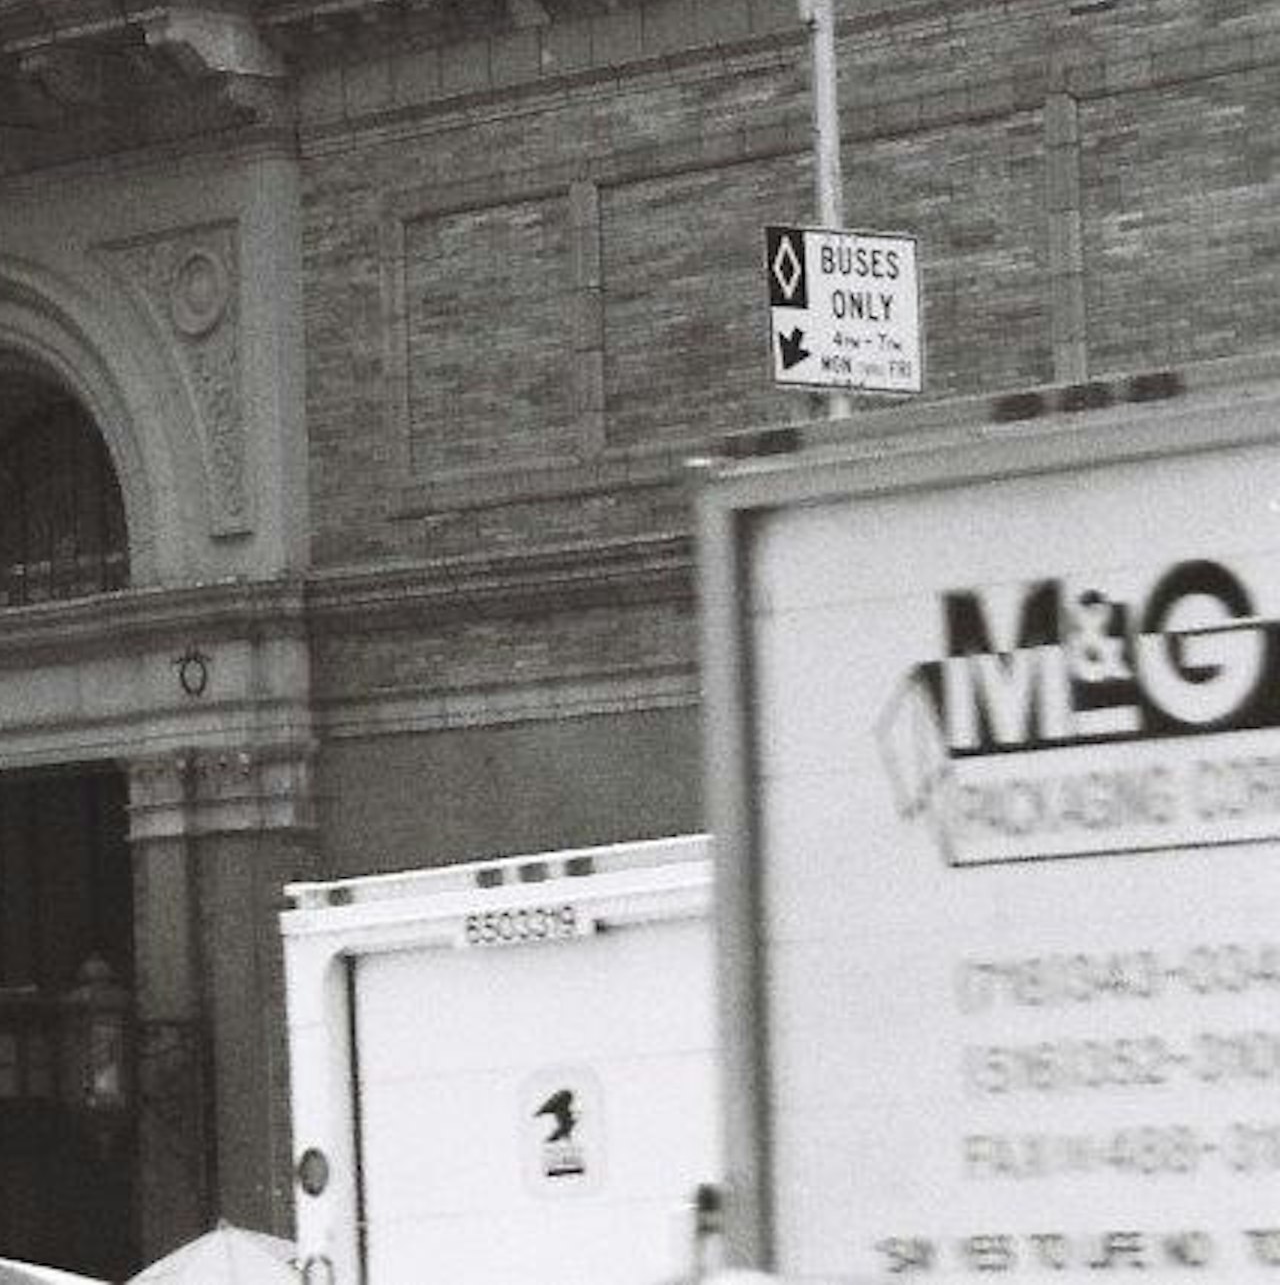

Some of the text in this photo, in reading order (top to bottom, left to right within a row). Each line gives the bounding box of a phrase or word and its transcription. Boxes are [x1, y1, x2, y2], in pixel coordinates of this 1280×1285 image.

[821, 246, 900, 280] BUSES
[831, 289, 893, 321] ONLY
[821, 355, 852, 374] MON
[940, 559, 1266, 752] M&G
